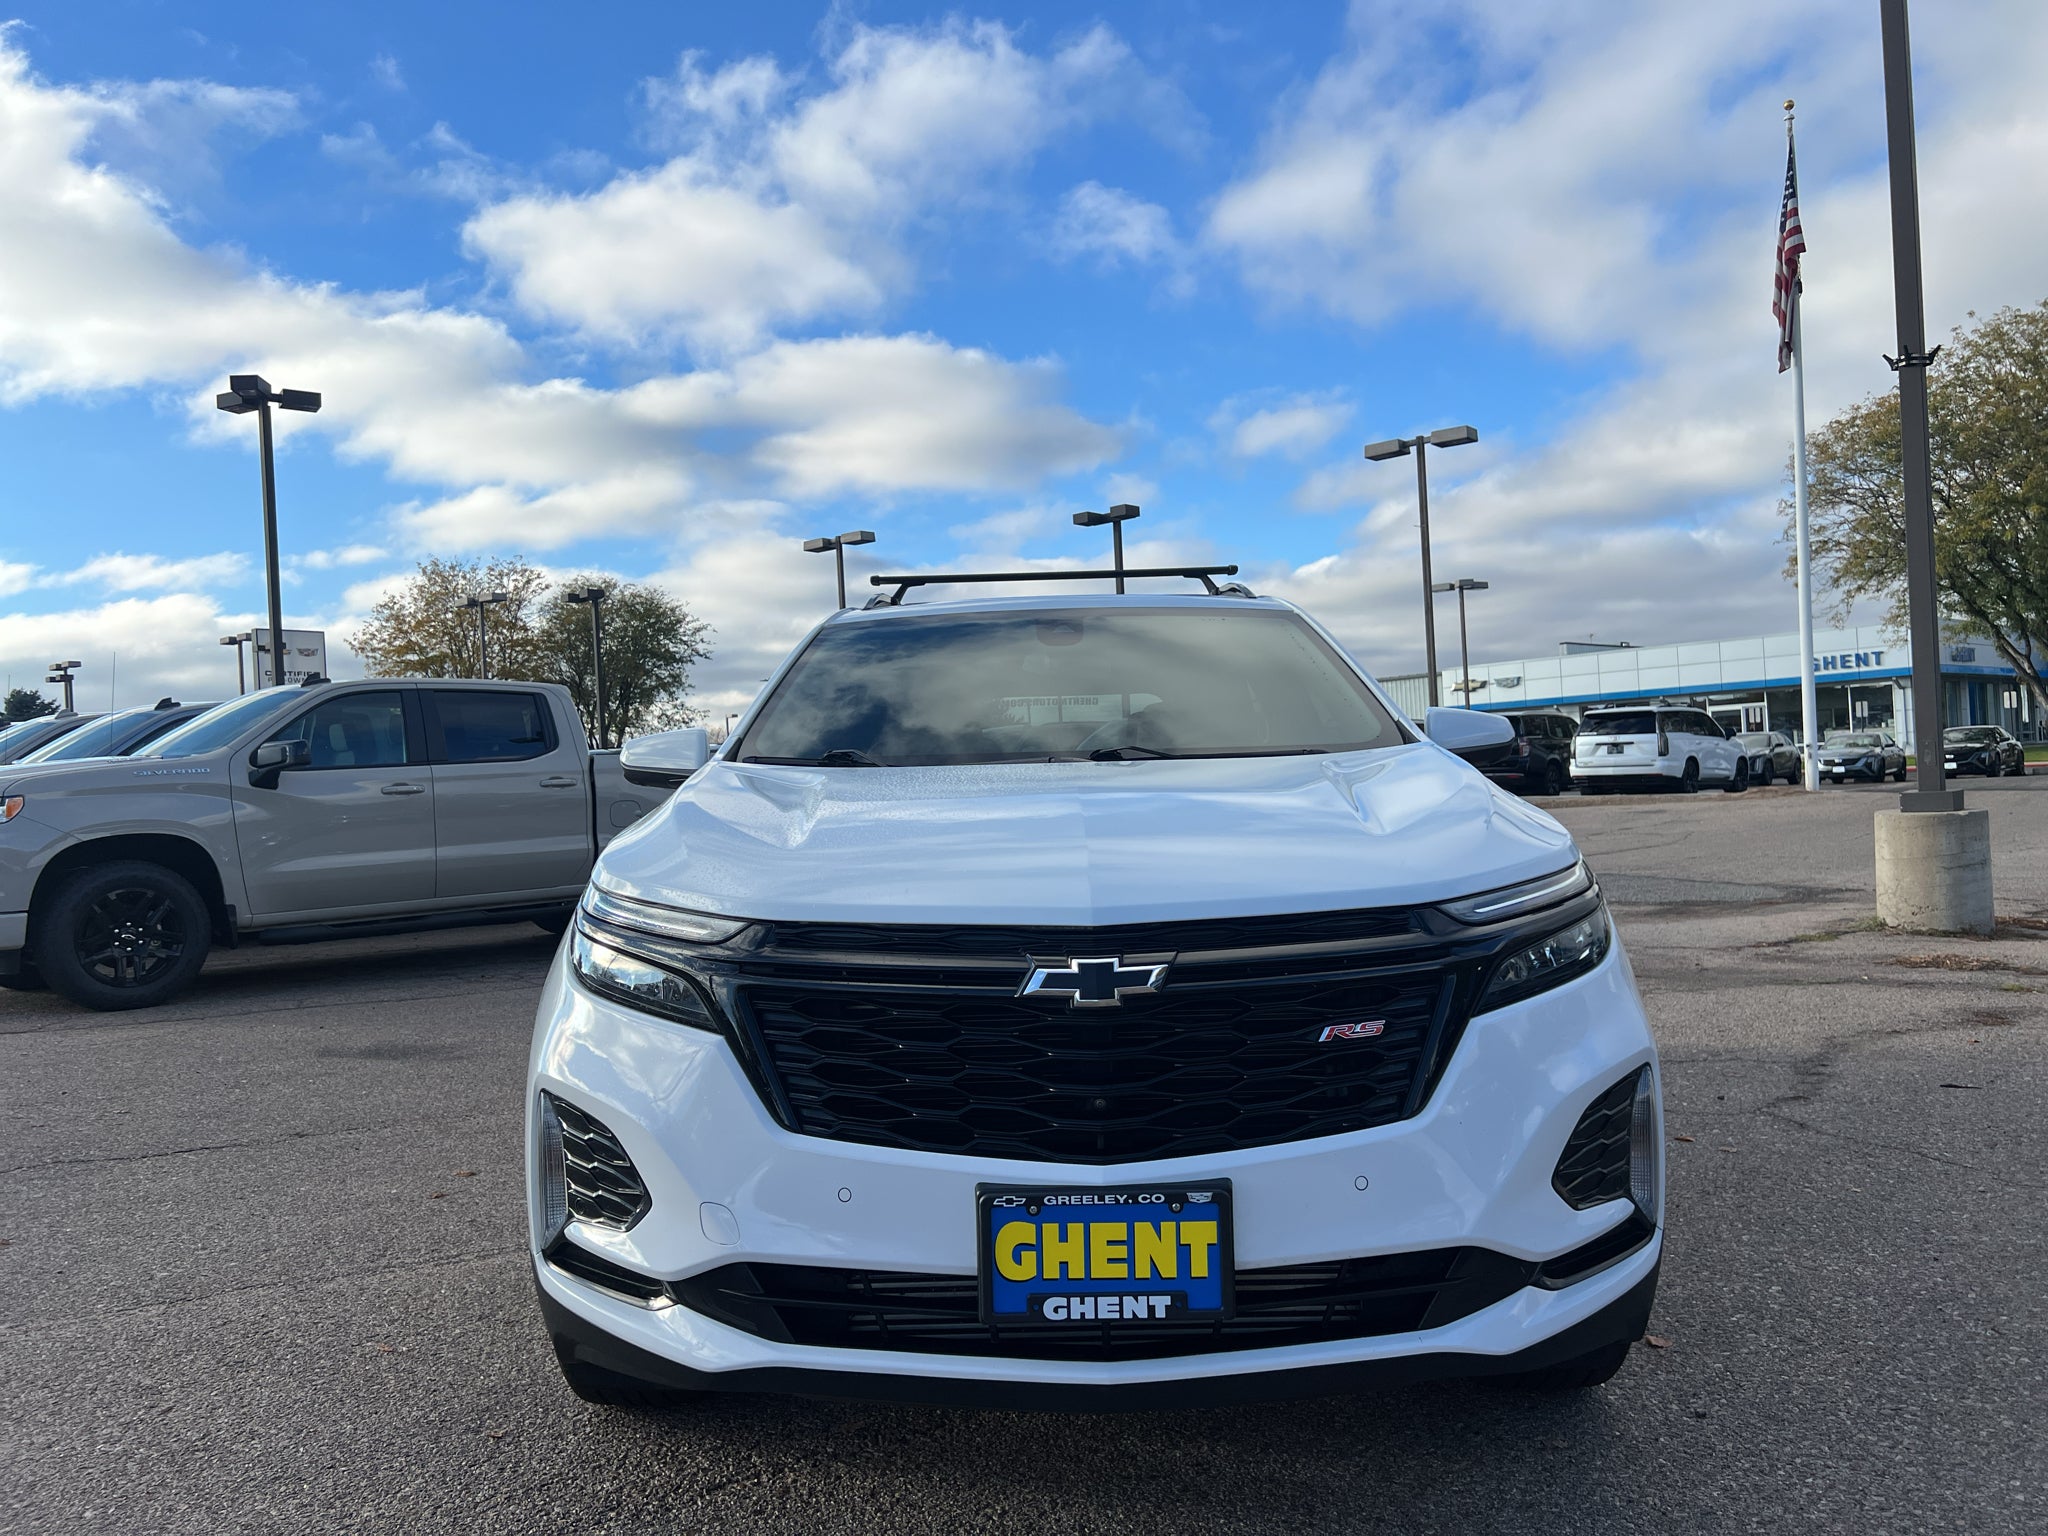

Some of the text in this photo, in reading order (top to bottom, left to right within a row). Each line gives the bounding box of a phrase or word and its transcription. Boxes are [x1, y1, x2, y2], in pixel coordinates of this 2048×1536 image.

[133, 767, 211, 777] SILVERADO
[1319, 1020, 1386, 1042] RS
[1043, 1193, 1166, 1206] GREELEY, CO
[994, 1220, 1218, 1282] GHENT
[1042, 1295, 1172, 1321] GHENT
